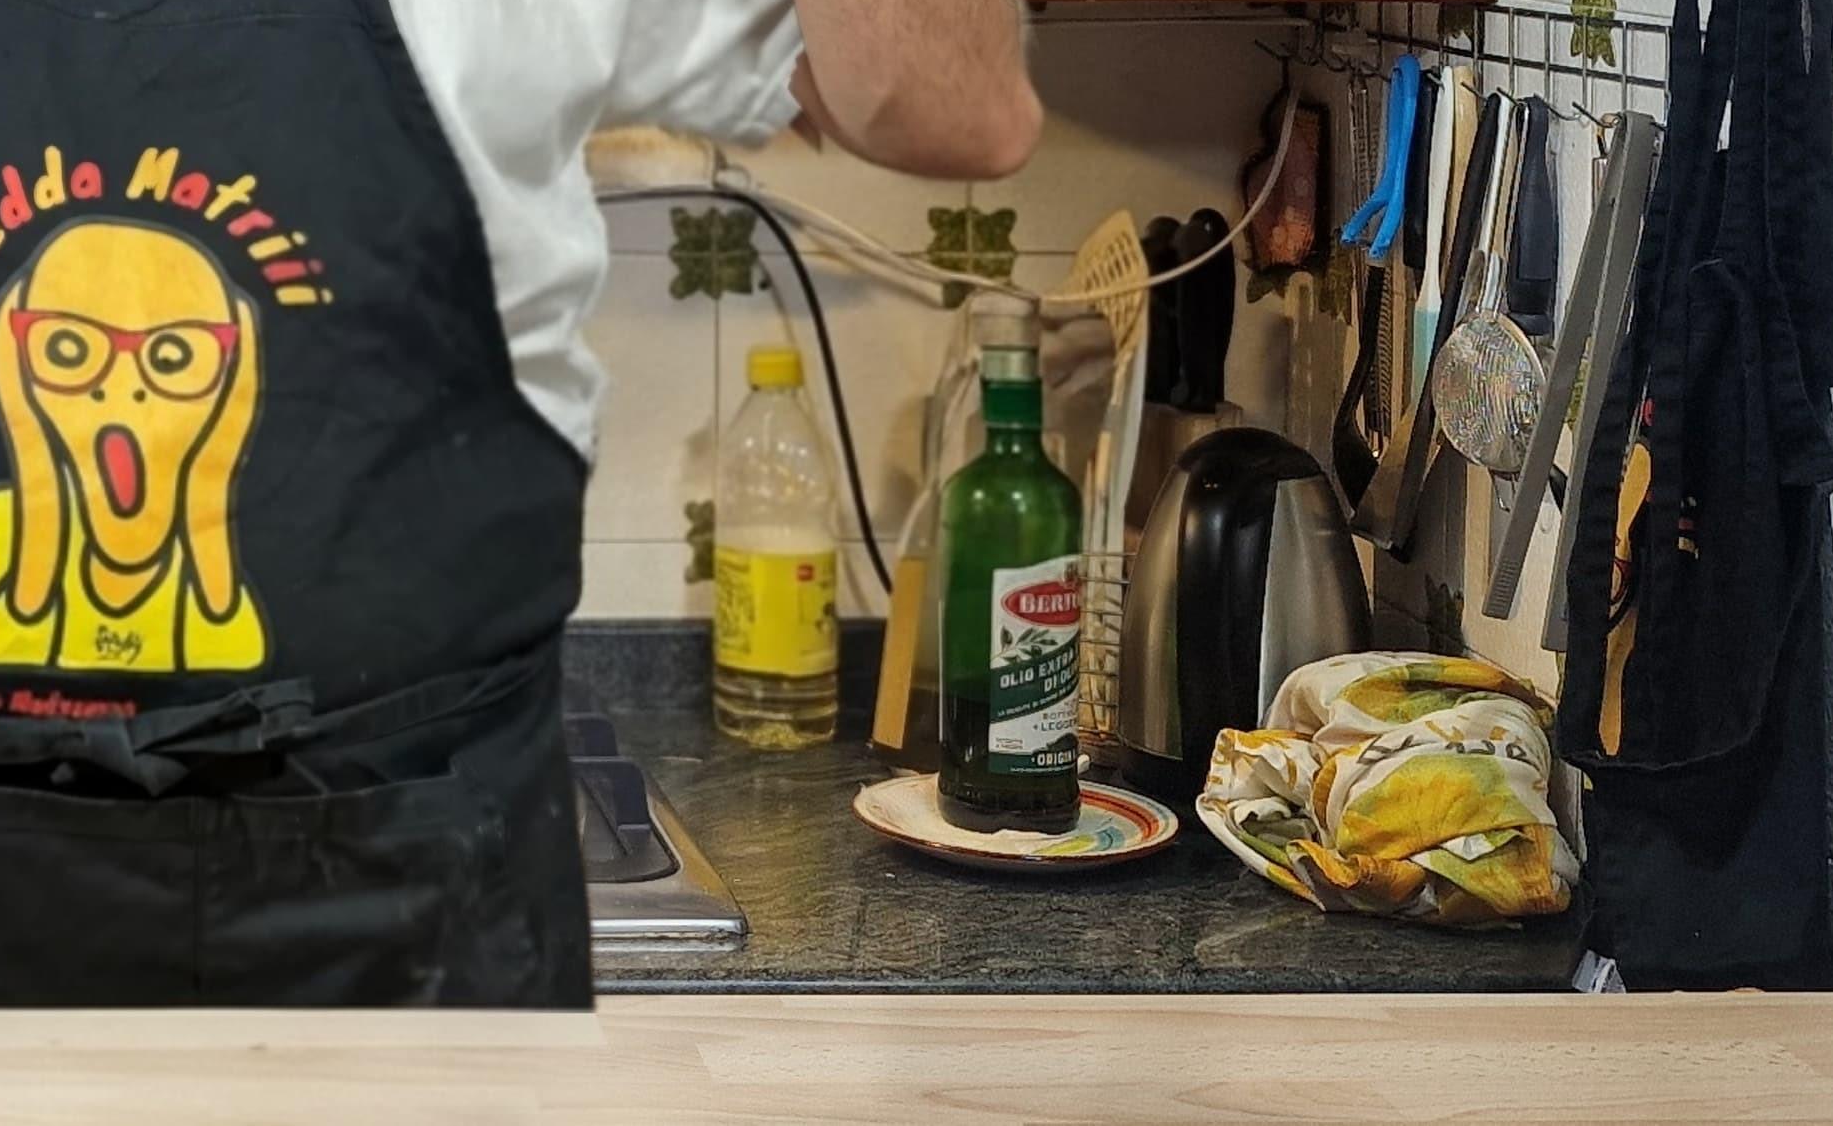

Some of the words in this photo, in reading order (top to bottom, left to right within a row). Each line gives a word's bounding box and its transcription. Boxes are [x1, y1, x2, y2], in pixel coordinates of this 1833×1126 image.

[125, 146, 334, 305] Matriii
[1000, 667, 1035, 689] OLIO
[1044, 675, 1058, 693] DI
